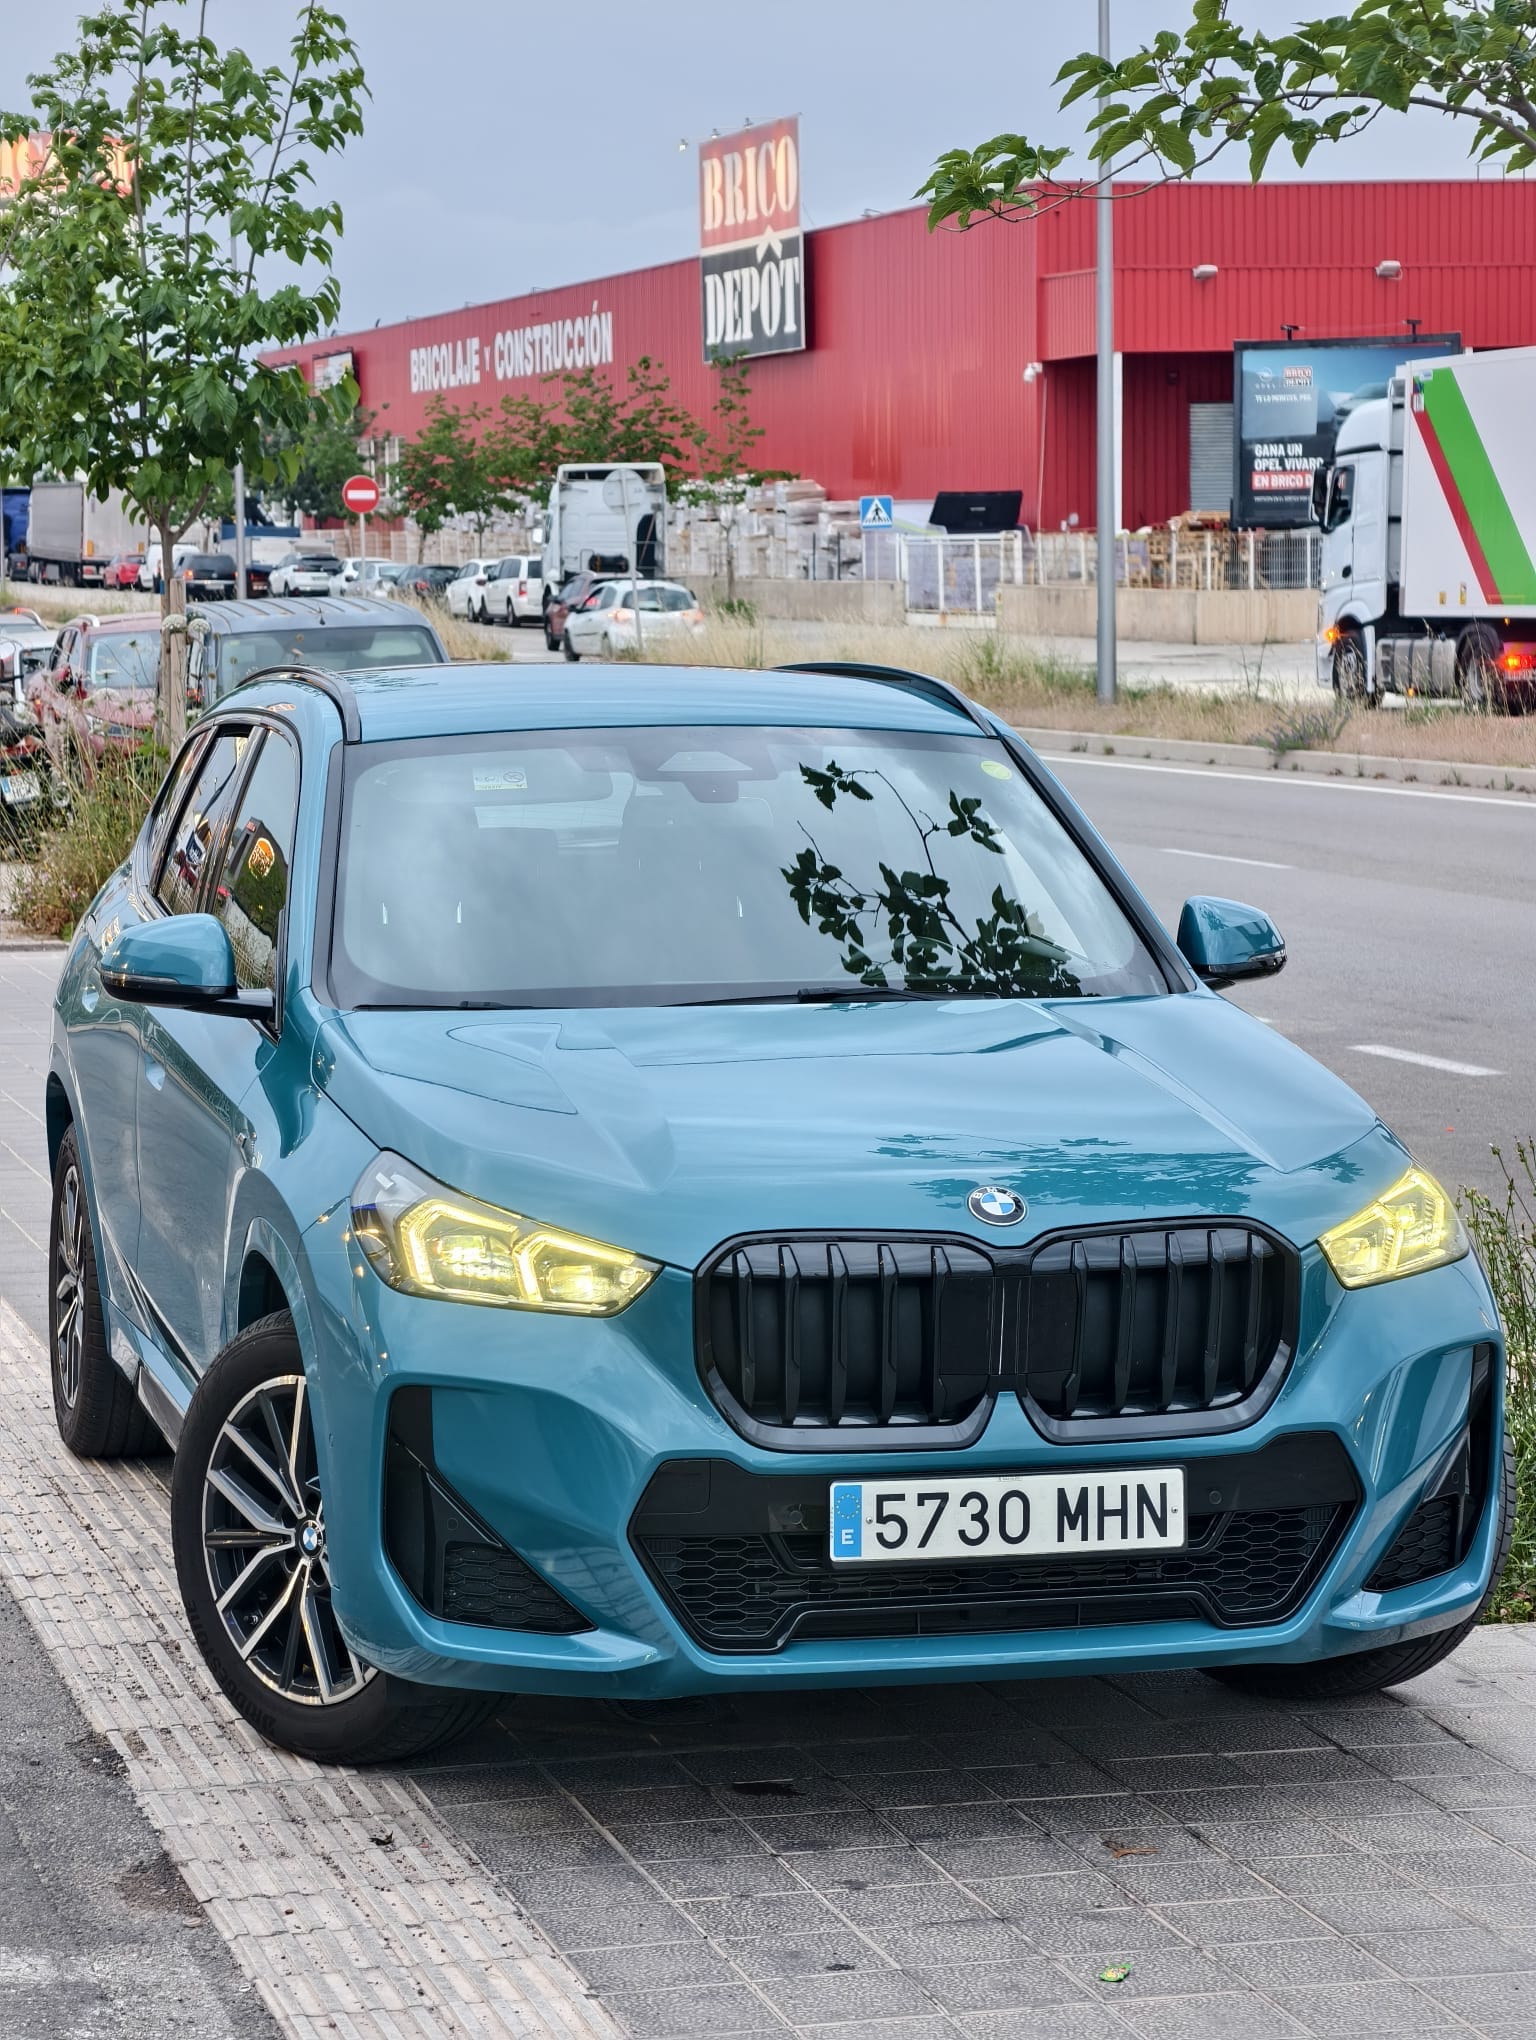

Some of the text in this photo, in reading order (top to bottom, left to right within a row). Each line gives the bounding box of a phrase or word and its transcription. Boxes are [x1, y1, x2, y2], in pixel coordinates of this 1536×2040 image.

[702, 134, 798, 232] BRICO
[704, 226, 800, 346] DEPÔT
[410, 300, 613, 394] BRICOLAJE Y CONSTRUCCIÓN
[1254, 443, 1303, 457] GANA UN
[1254, 458, 1282, 471] OPEL
[1255, 474, 1269, 487] EN
[1270, 473, 1301, 487] BRICO
[841, 1529, 854, 1545] E
[875, 1489, 1030, 1549] 5730
[1056, 1482, 1167, 1543] MHN
[185, 1600, 277, 1734] BRIDGESTONE
